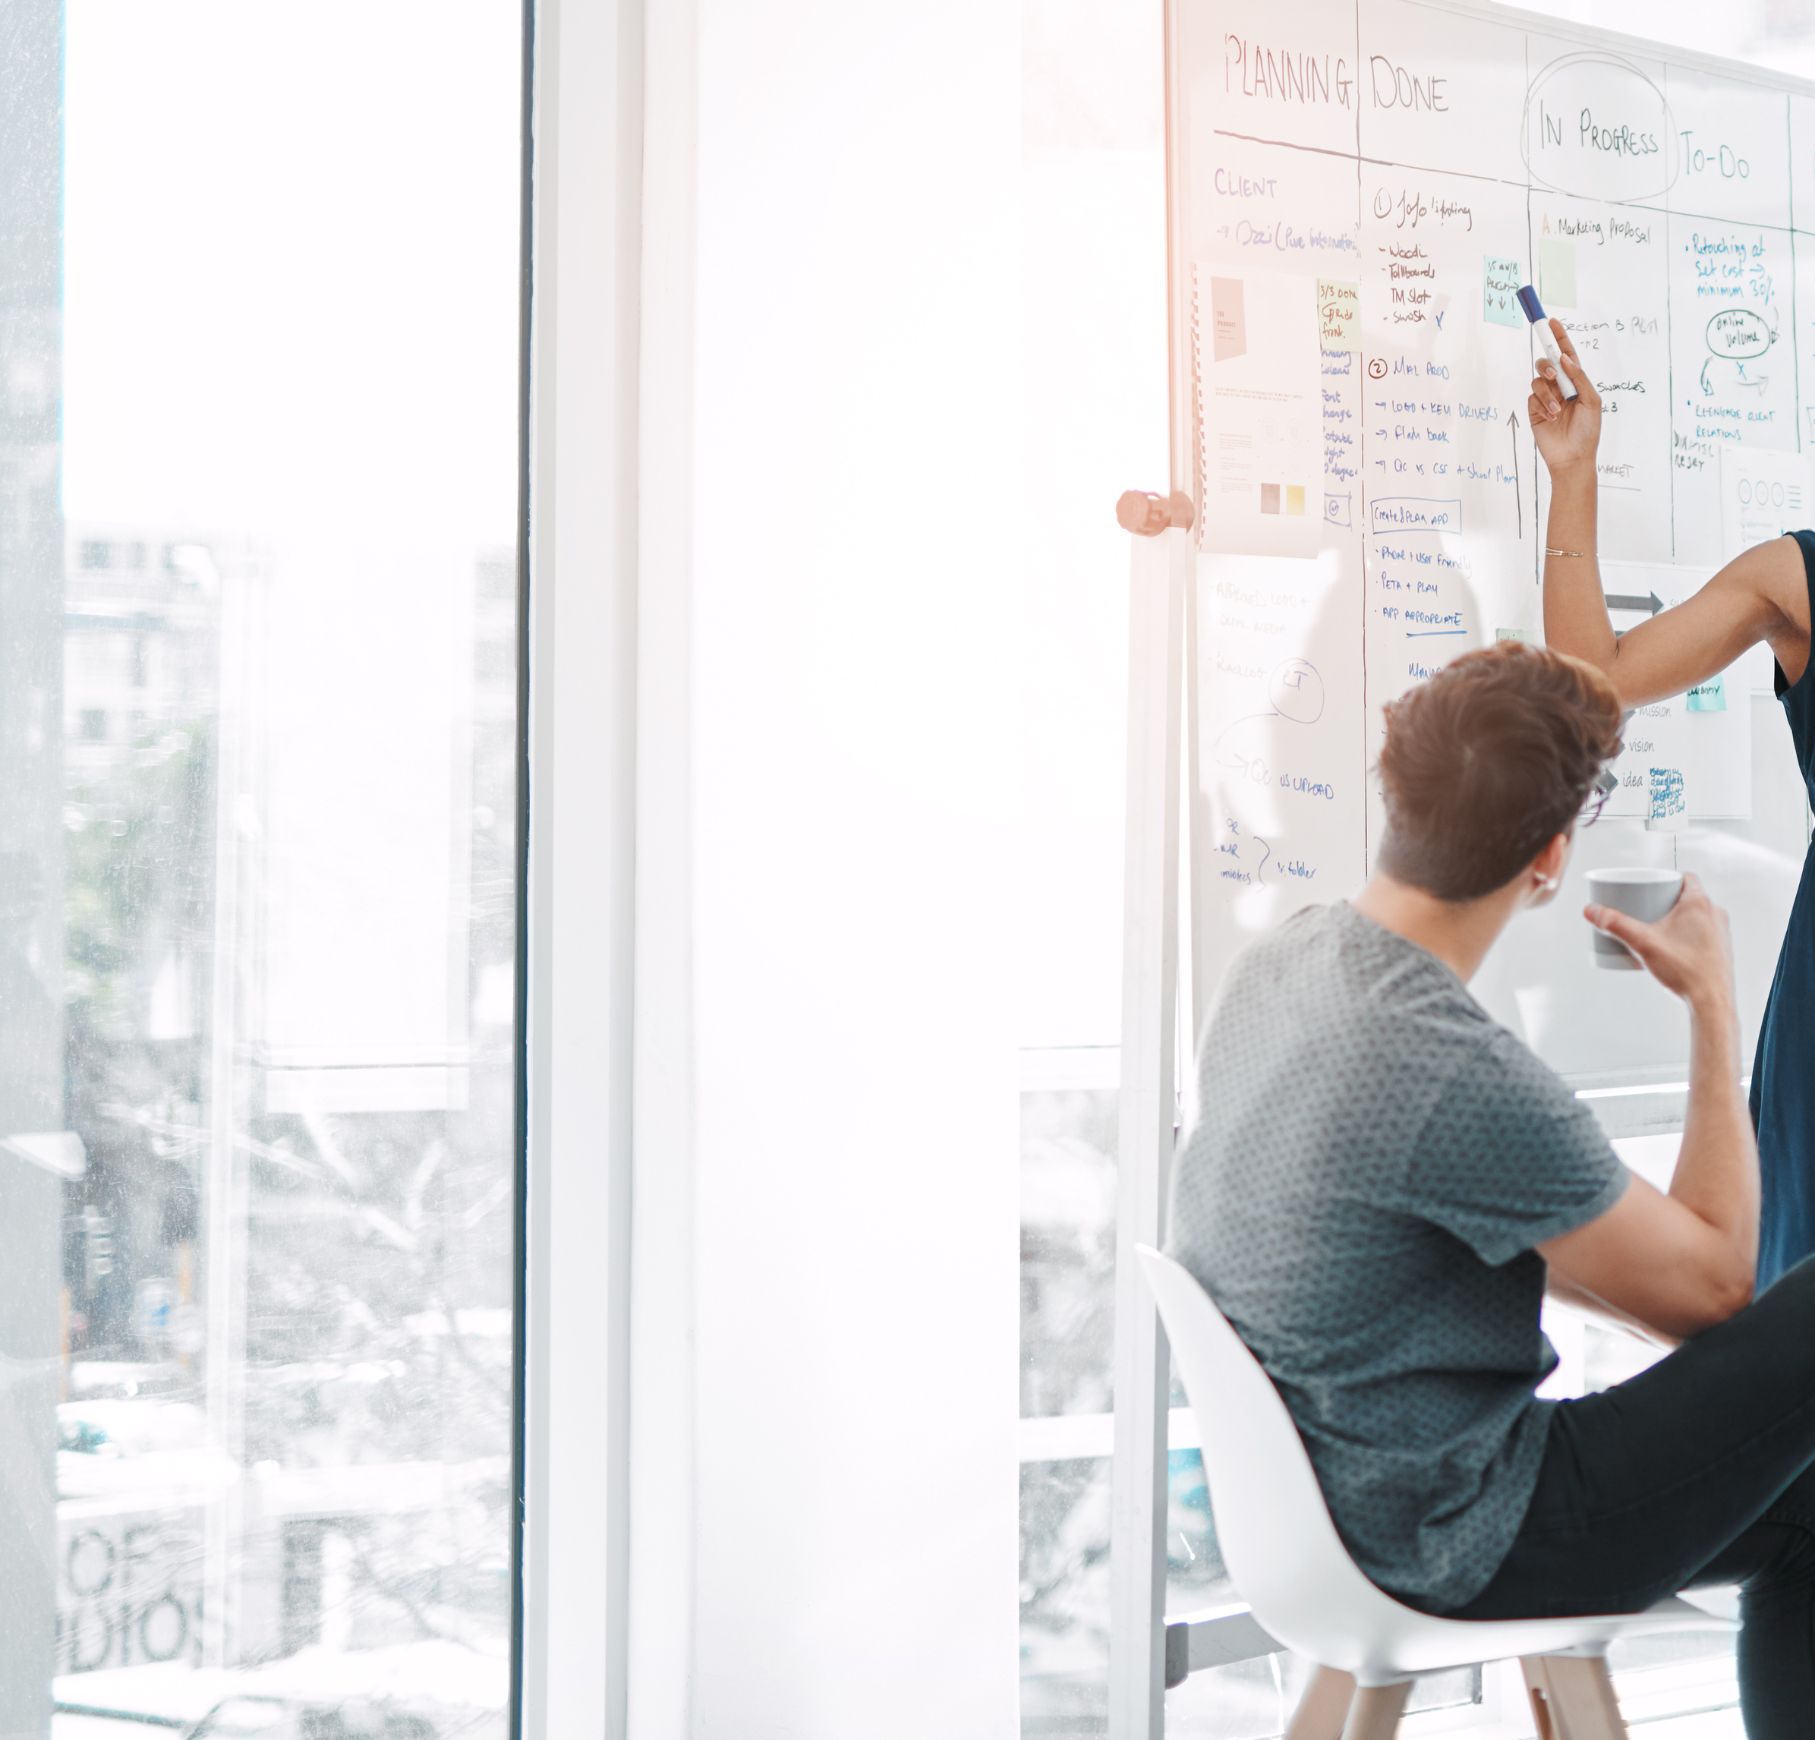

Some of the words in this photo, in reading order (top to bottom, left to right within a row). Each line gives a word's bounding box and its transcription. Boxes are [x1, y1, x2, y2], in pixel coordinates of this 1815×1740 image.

[1225, 32, 1352, 110] PLANNING
[1370, 55, 1449, 112] DONE
[1540, 98, 1562, 149] IN
[1579, 108, 1659, 157] PROGRESS
[1214, 168, 1277, 198] CLIENT
